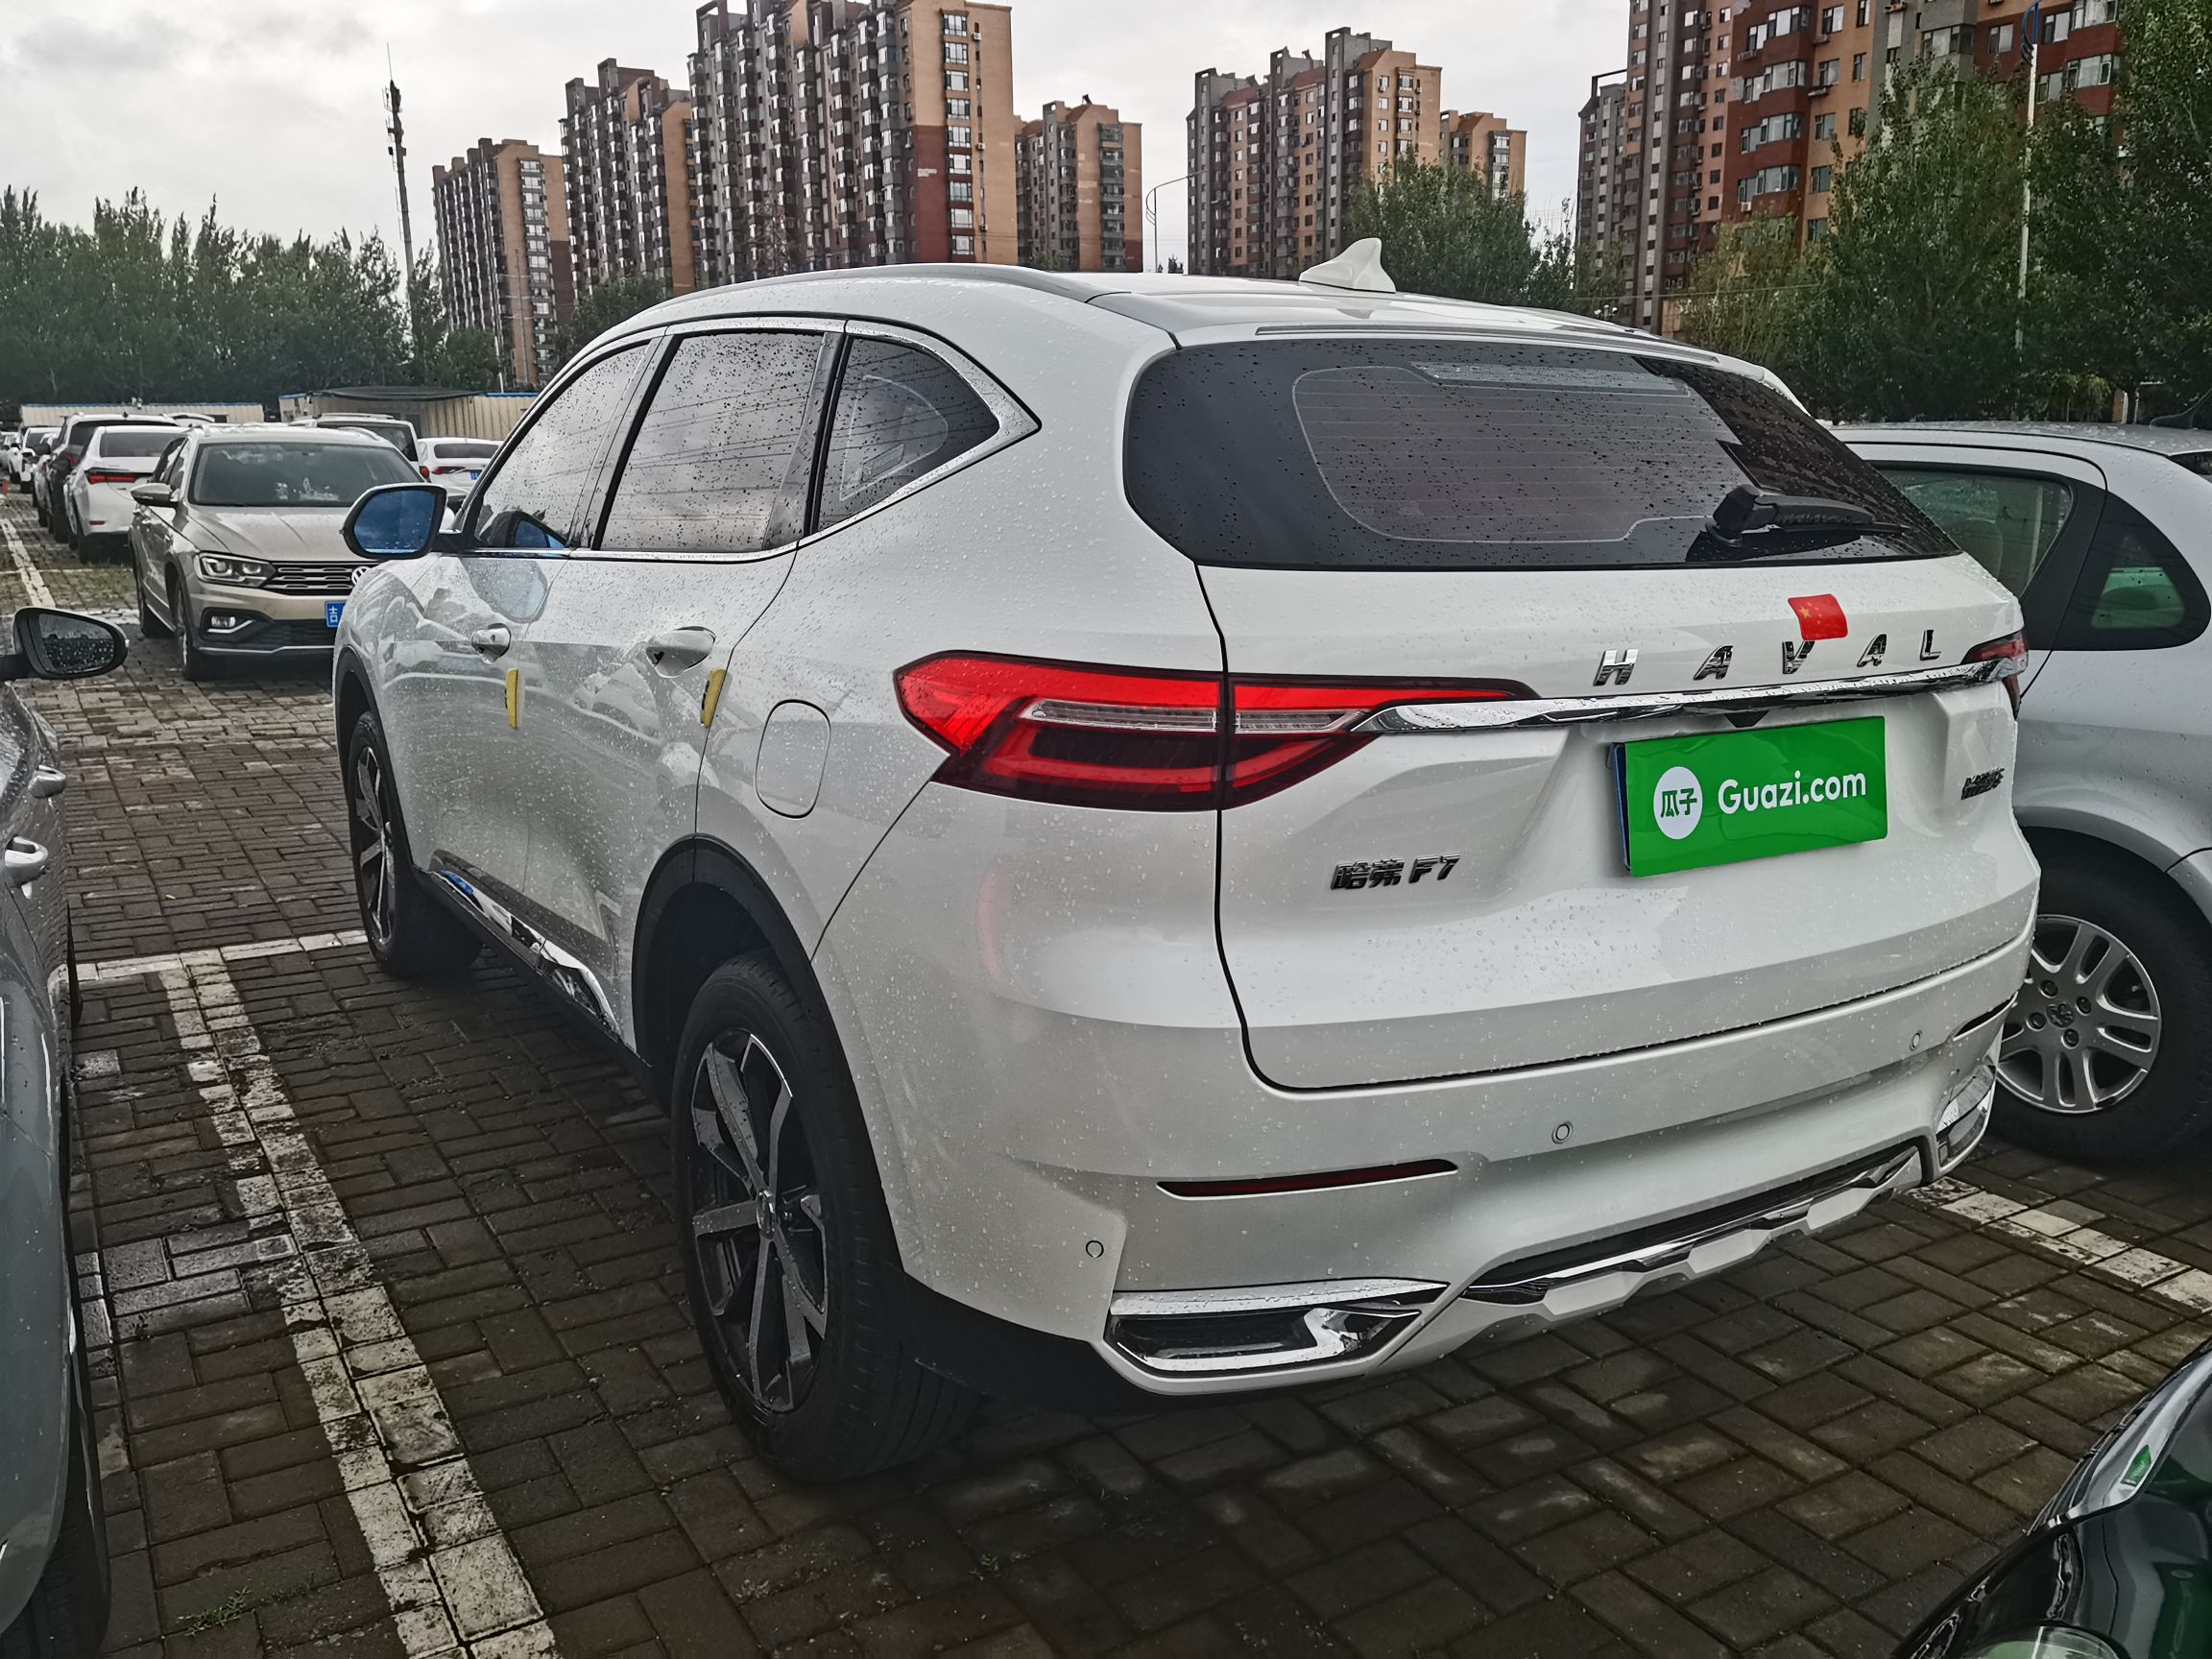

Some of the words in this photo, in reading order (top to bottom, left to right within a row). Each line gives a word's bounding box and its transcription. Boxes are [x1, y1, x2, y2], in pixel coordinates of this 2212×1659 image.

[1593, 630, 1941, 686] HAVAL
[1660, 787, 1697, 818] 瓜子
[1718, 770, 1866, 814] Guazi.com
[1408, 854, 1461, 884] F7
